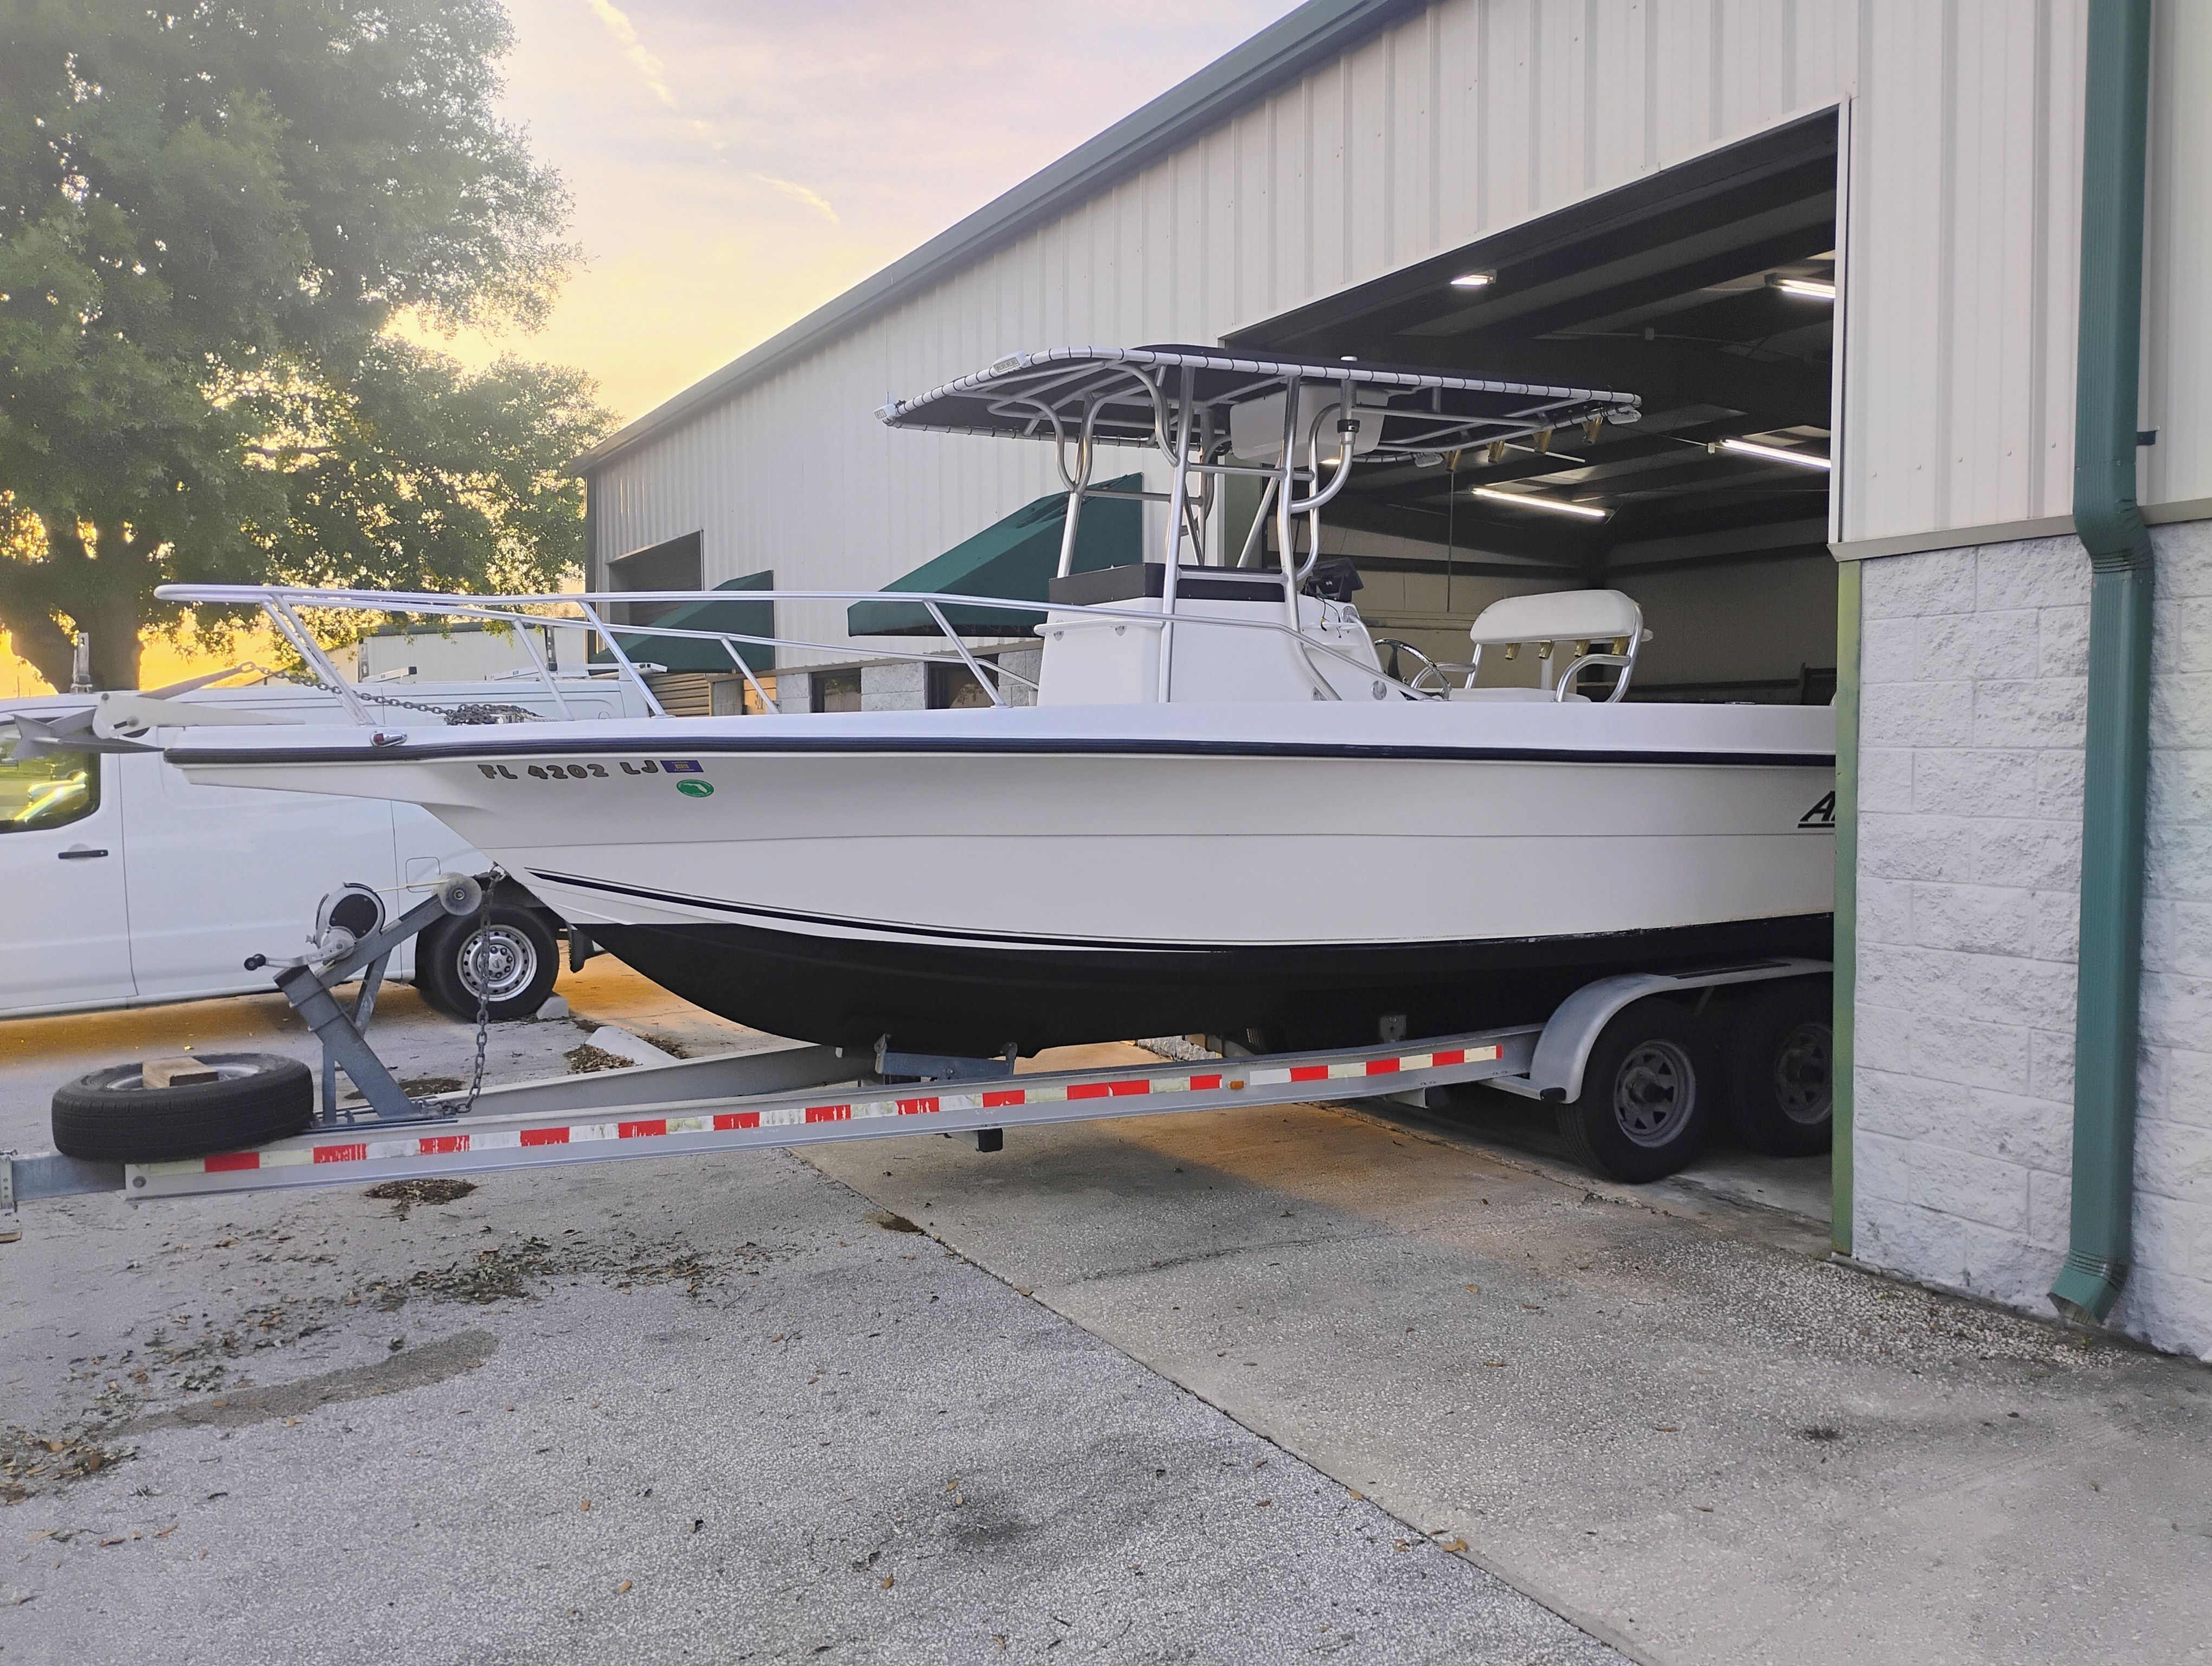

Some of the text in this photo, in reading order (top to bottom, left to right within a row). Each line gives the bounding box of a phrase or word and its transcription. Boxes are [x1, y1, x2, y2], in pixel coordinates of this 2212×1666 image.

[477, 760, 659, 779] FL 4202 LJ
[1799, 790, 1836, 822] A
